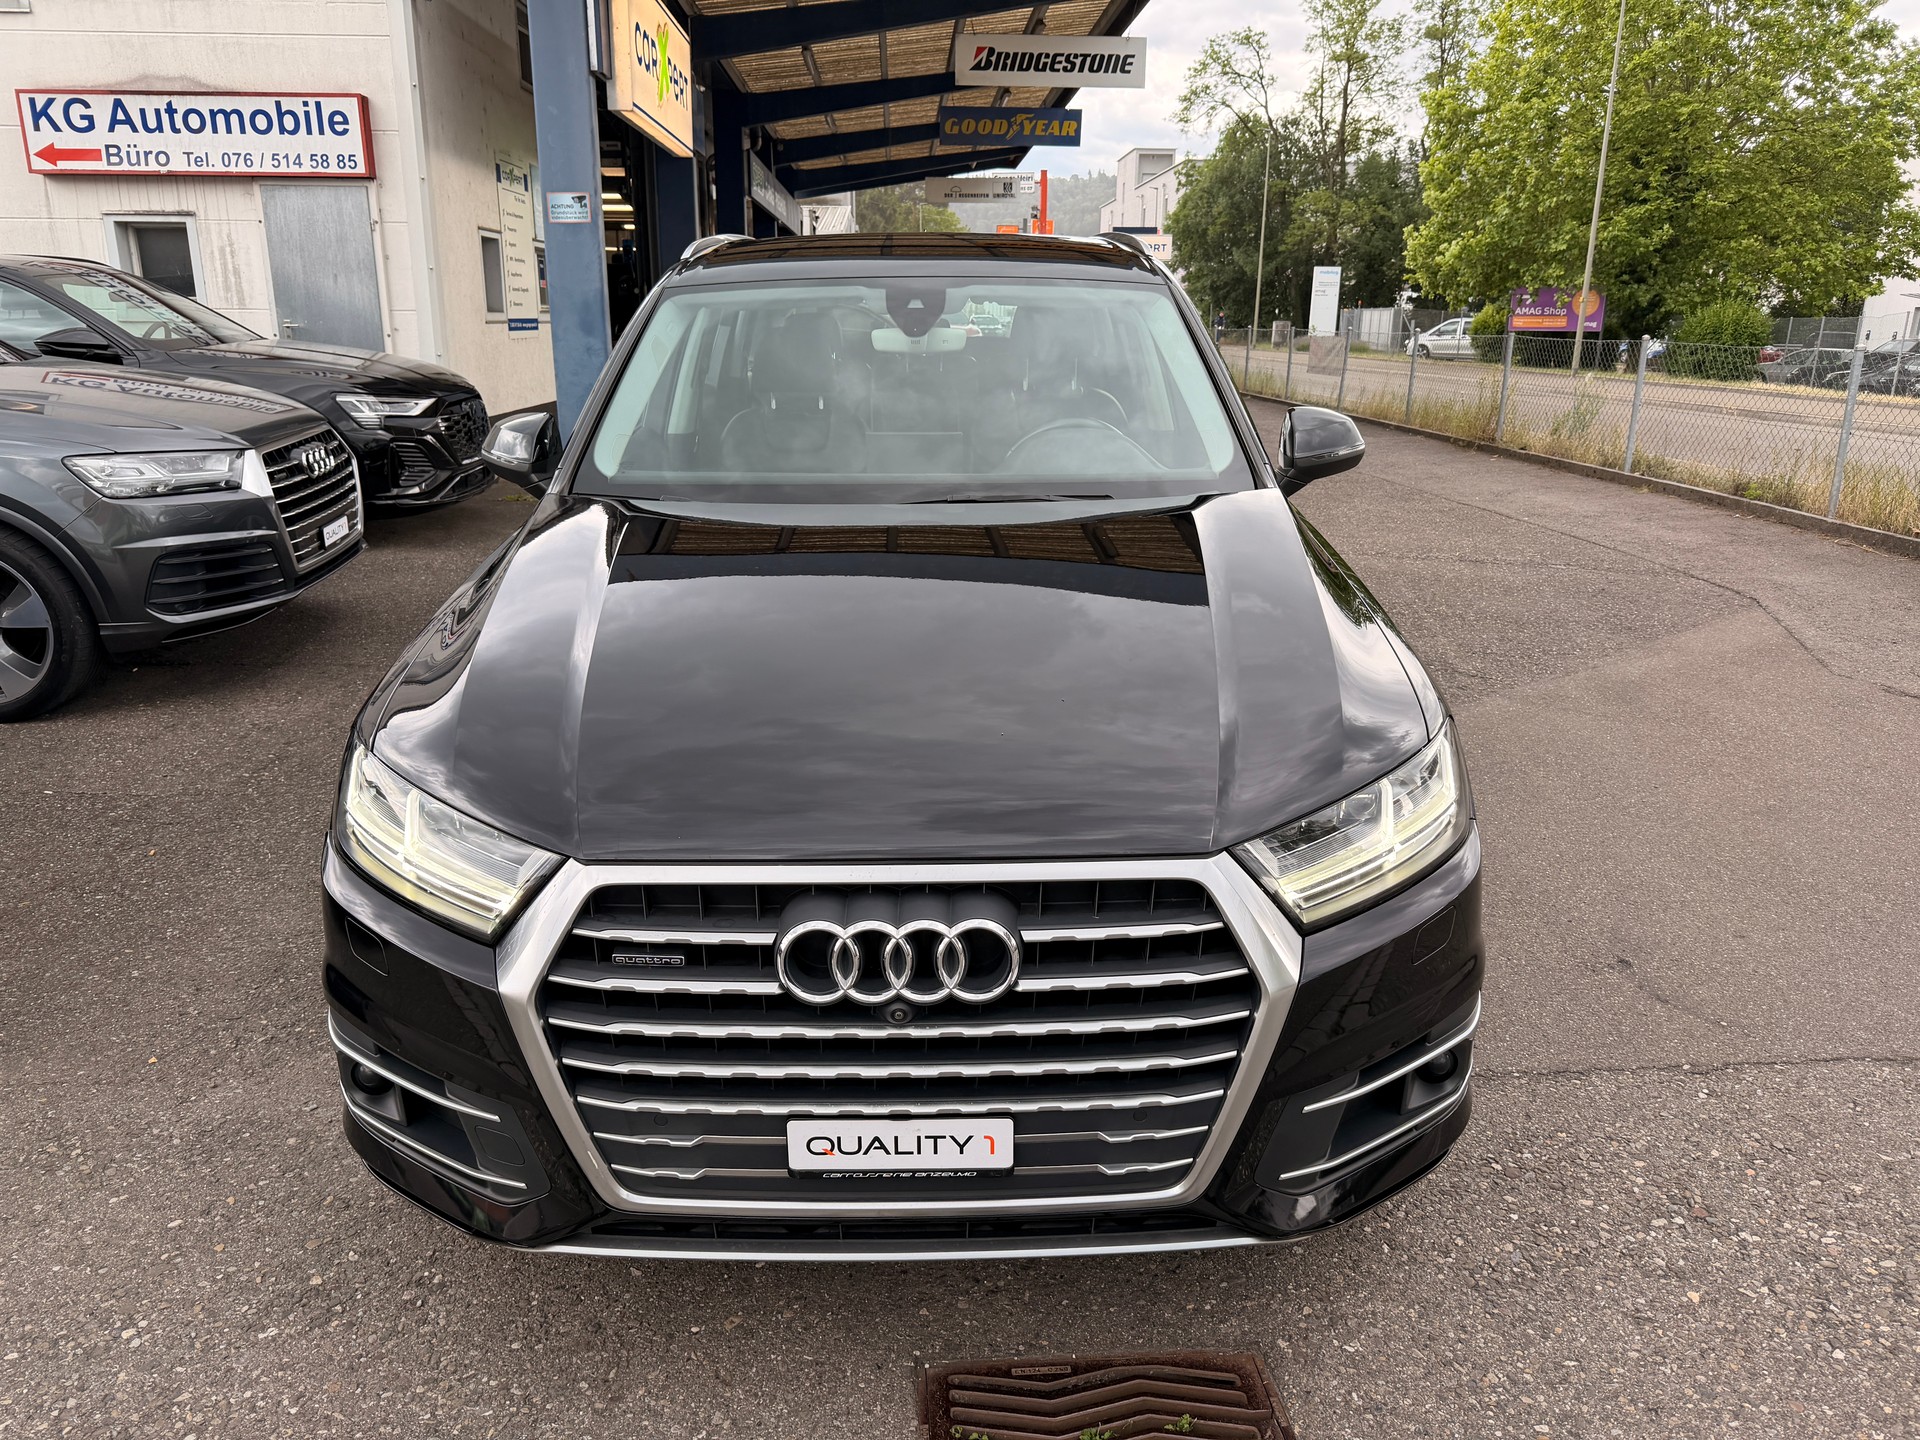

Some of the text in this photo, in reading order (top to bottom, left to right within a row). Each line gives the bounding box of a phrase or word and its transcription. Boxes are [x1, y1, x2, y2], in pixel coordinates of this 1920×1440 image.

[969, 46, 1136, 74] BRIDGESTONE
[28, 97, 350, 137] KG Automobile
[104, 143, 171, 167] Büro
[182, 151, 216, 168] Tel.
[221, 152, 253, 169] 076
[271, 152, 303, 169] 514
[309, 153, 330, 169] 58
[336, 153, 358, 170] 85
[1515, 307, 1567, 316] AMAG Shop
[615, 956, 681, 965] quattro
[805, 1135, 974, 1156] QUALITY
